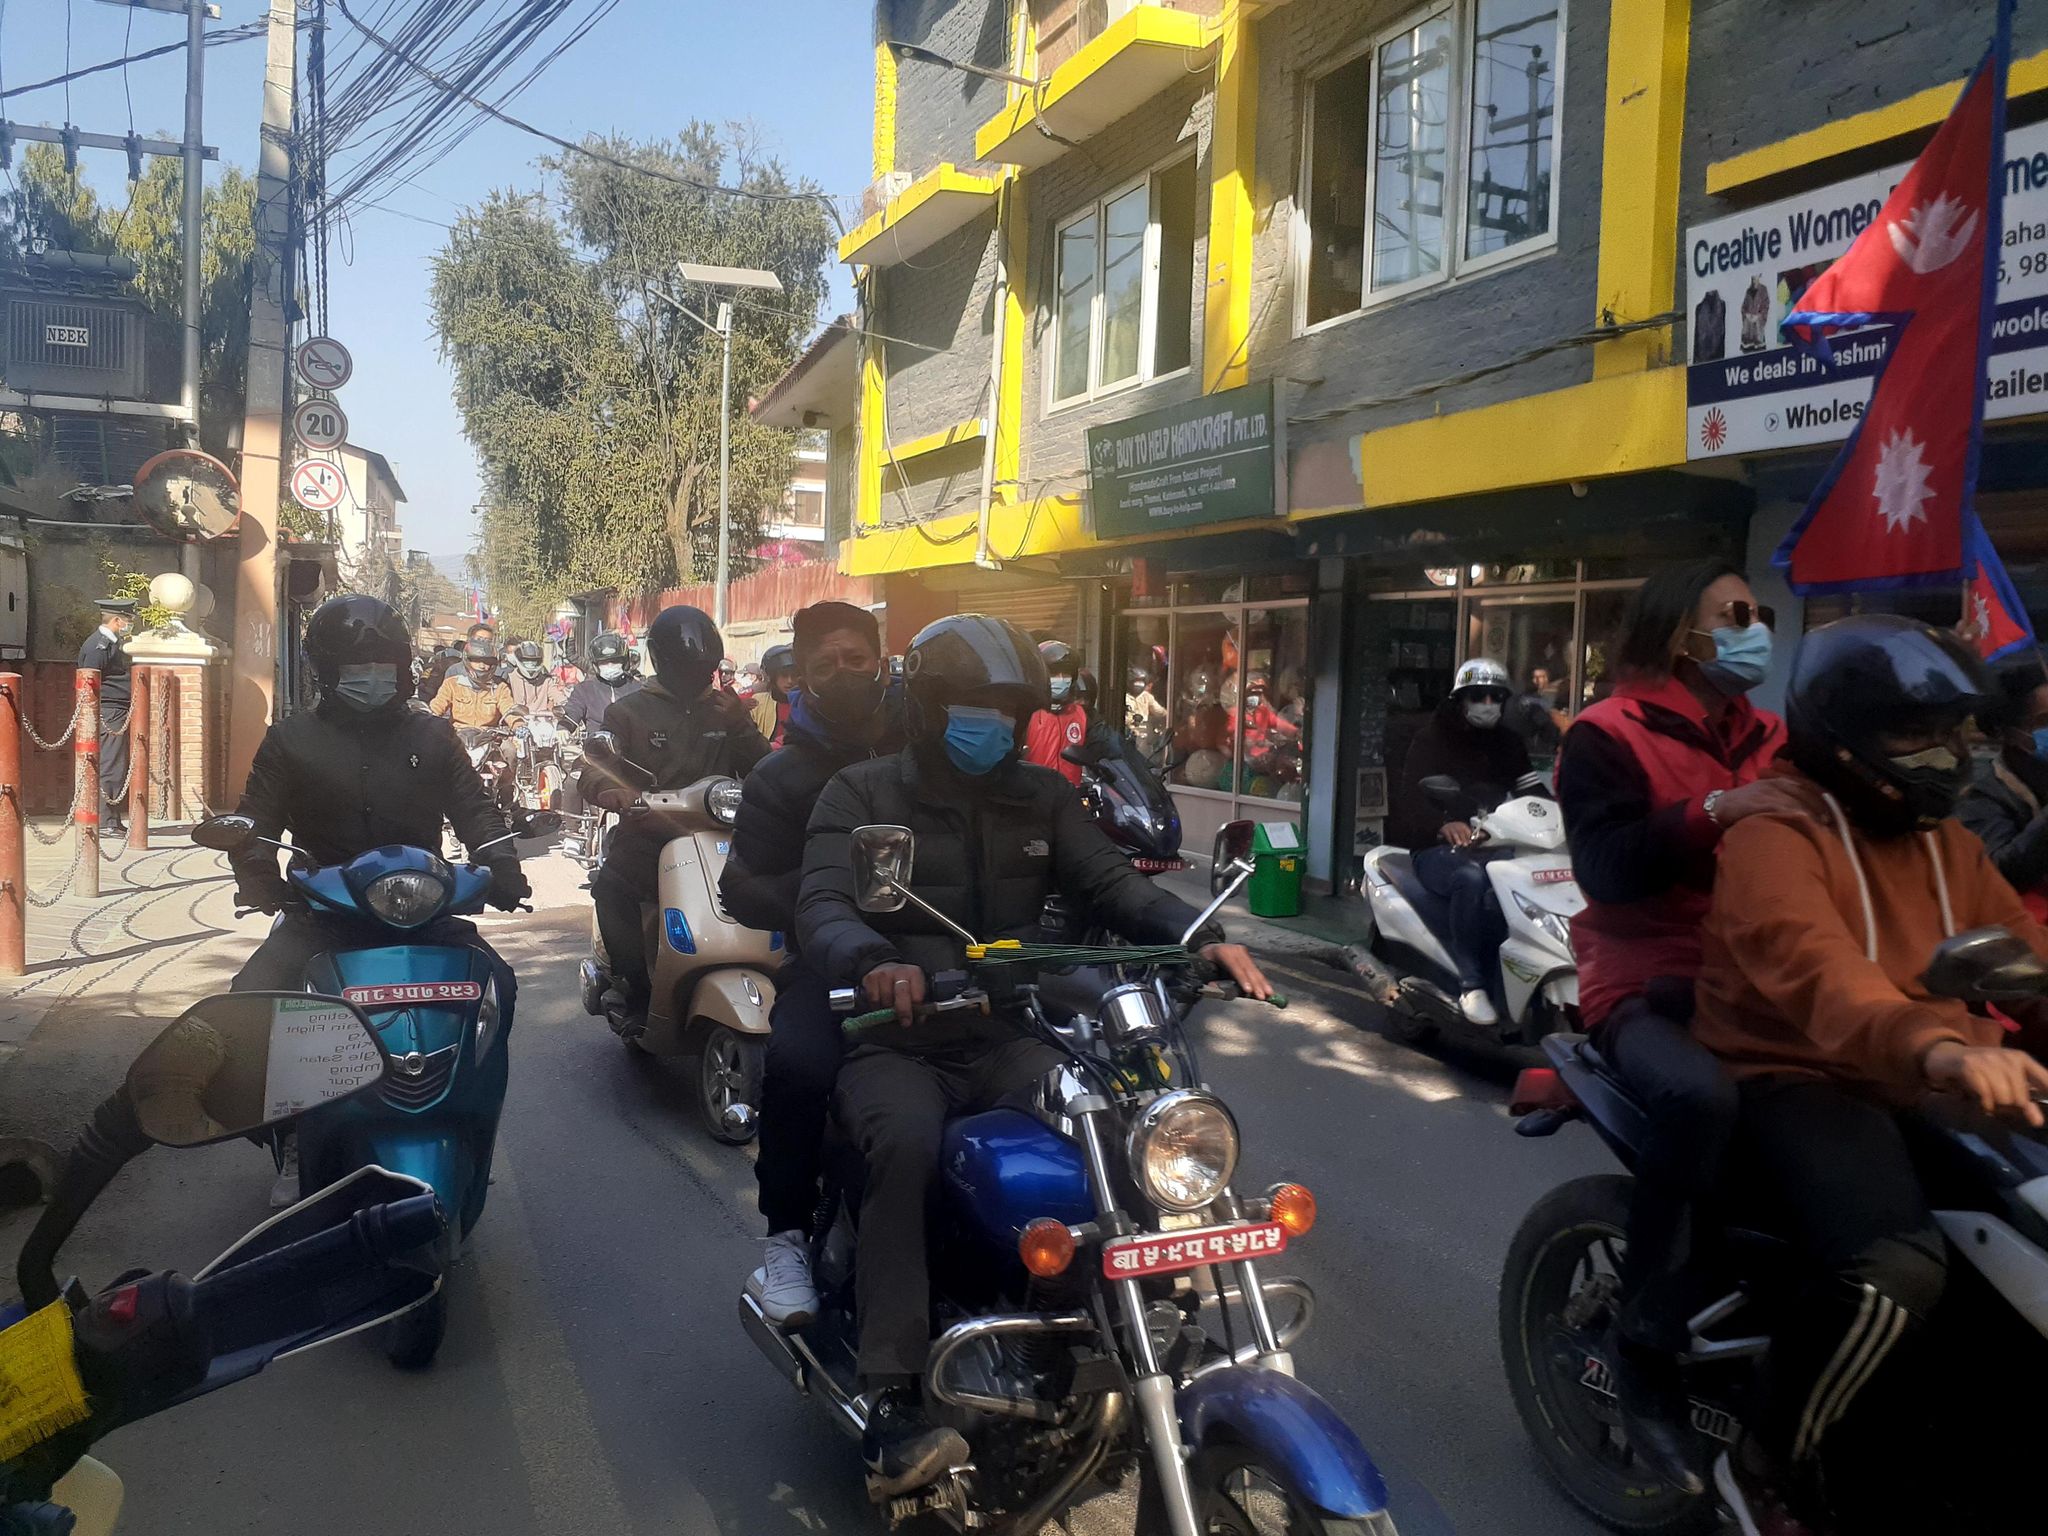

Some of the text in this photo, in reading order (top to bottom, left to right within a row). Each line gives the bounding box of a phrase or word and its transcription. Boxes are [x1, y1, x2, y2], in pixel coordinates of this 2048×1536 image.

[1694, 227, 1781, 278] Creative
[47, 327, 88, 344] NEEK
[1725, 366, 1748, 387] We
[1753, 356, 1796, 380] deals
[1802, 353, 1817, 373] in
[306, 413, 336, 437] 20
[1786, 399, 1864, 430] Wholes
[1116, 437, 1134, 469] BUY
[1135, 433, 1147, 465] TO
[1148, 427, 1169, 465] HELP
[1171, 410, 1233, 459] HANDICRAFT
[1251, 413, 1268, 439] LTD.
